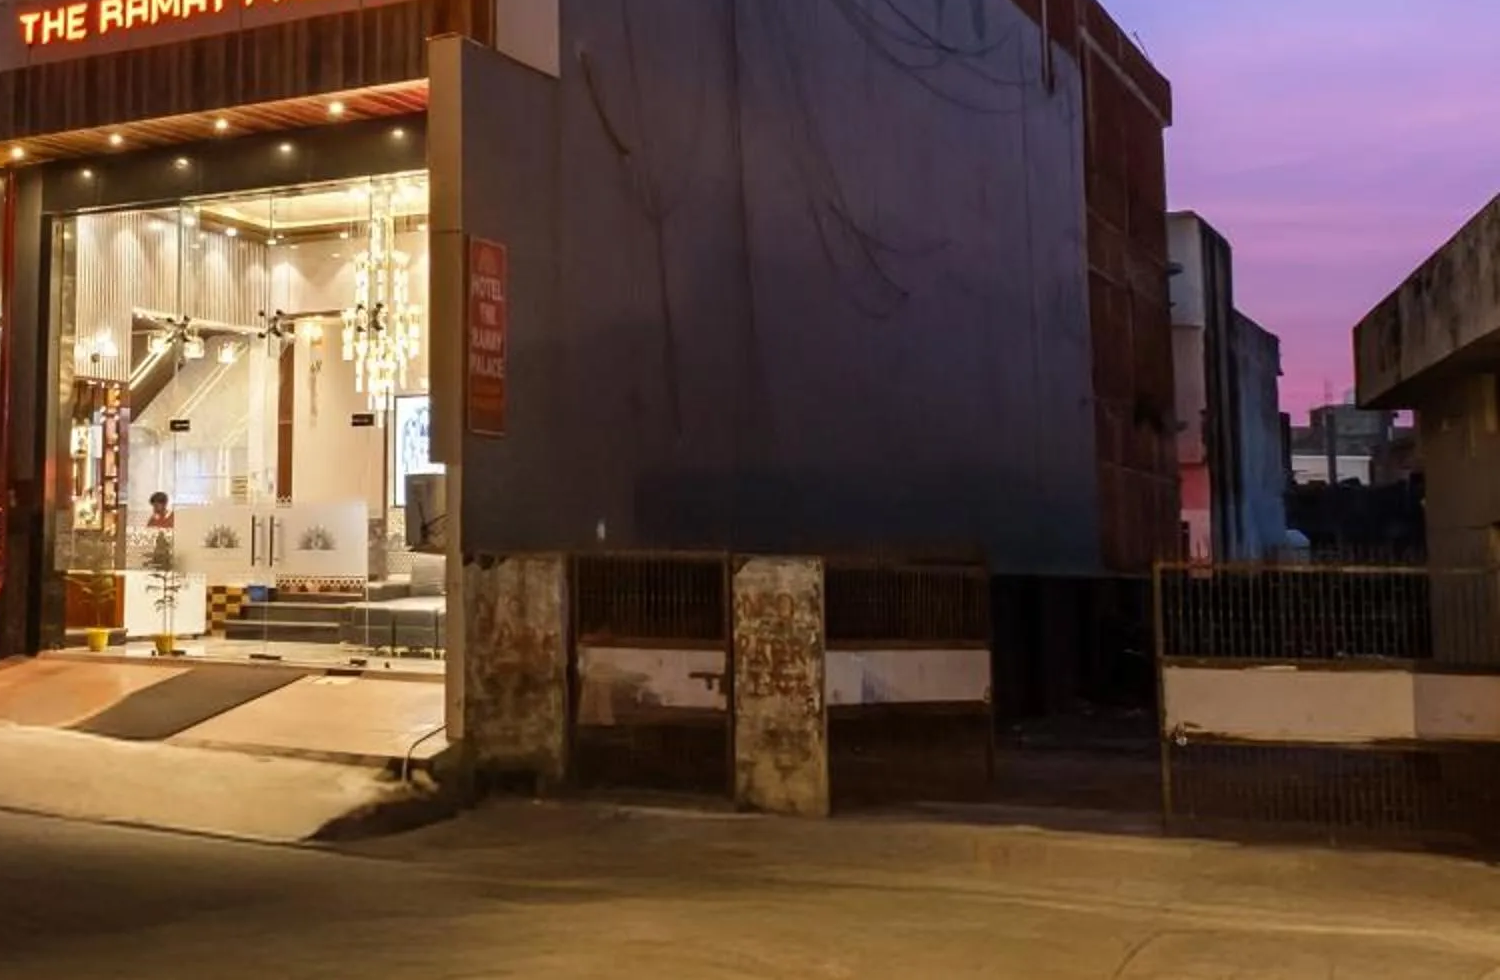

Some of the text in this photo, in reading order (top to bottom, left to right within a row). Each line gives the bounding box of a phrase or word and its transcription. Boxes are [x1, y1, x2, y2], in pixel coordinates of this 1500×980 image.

[19, 2, 88, 45] THE
[470, 273, 503, 301] HOTEL
[471, 353, 505, 379] PALACE
